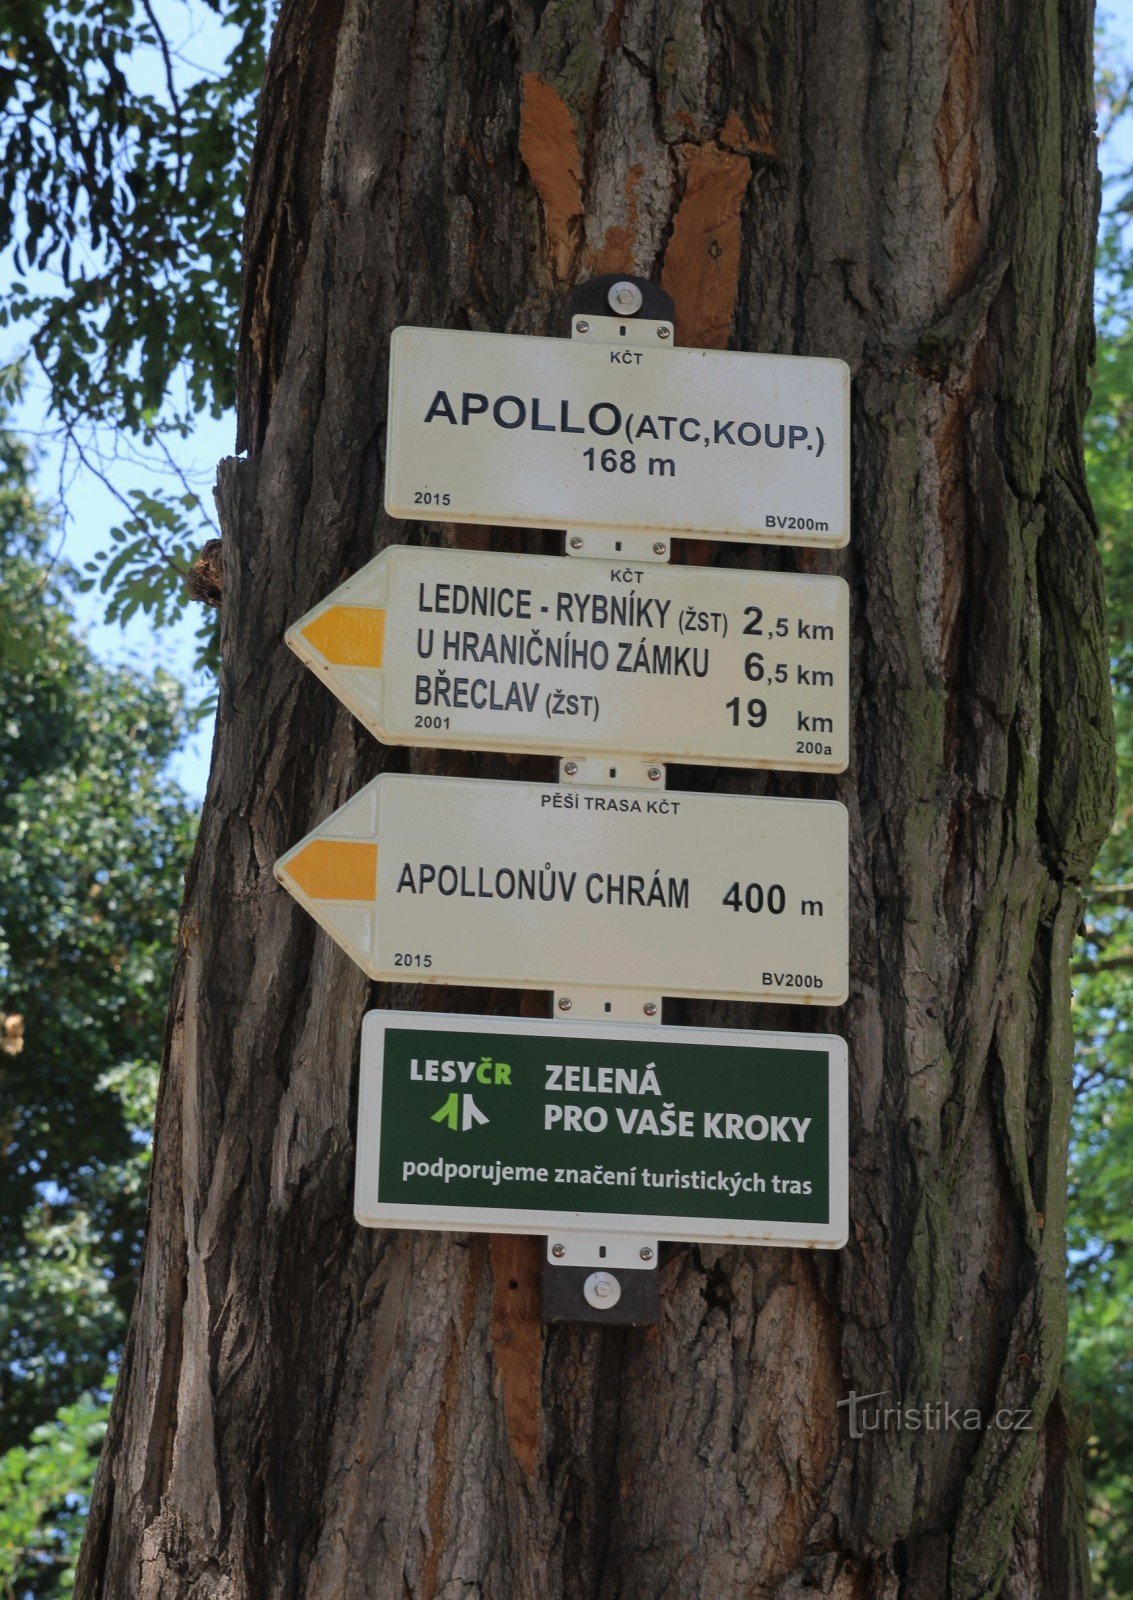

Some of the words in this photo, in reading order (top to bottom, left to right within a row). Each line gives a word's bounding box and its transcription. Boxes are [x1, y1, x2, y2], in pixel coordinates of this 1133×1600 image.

[610, 350, 643, 365] KČT
[583, 447, 636, 474] 168
[649, 457, 676, 476] m
[414, 491, 451, 506] 2015
[765, 515, 829, 532] BV200m
[610, 568, 644, 584] KČT
[418, 583, 532, 619] LEDNICE
[556, 590, 671, 629] RYBNÍKY
[679, 606, 728, 638] (ŽST)
[798, 619, 834, 640] km
[417, 628, 433, 658] U
[443, 629, 608, 670] HRANIČNÍHO
[616, 638, 709, 678] ZÁMKU
[797, 665, 834, 686] km
[415, 669, 540, 712] BŘECLAV
[545, 689, 600, 721] (ŽST)
[725, 697, 767, 728] 19
[798, 711, 833, 733] km
[414, 715, 450, 729] 2001
[796, 742, 832, 756] 200a
[541, 794, 579, 809] PĚŠÍ
[584, 797, 642, 813] TRASA
[647, 798, 681, 815] KČT
[397, 862, 577, 902] APOLLONŮV
[586, 869, 690, 908] CHRÁM
[722, 882, 786, 915] 400
[801, 900, 824, 916] m
[394, 954, 432, 968] 2015
[762, 972, 823, 989] BV200b
[545, 1062, 662, 1096] ZELENÁ
[544, 1105, 608, 1133] PRO
[616, 1103, 694, 1137] VAŠE
[704, 1112, 812, 1143] KROKY
[402, 1158, 549, 1185] podporujeme
[554, 1164, 636, 1186] značení
[642, 1170, 766, 1196] turistických
[772, 1175, 812, 1195] tras
